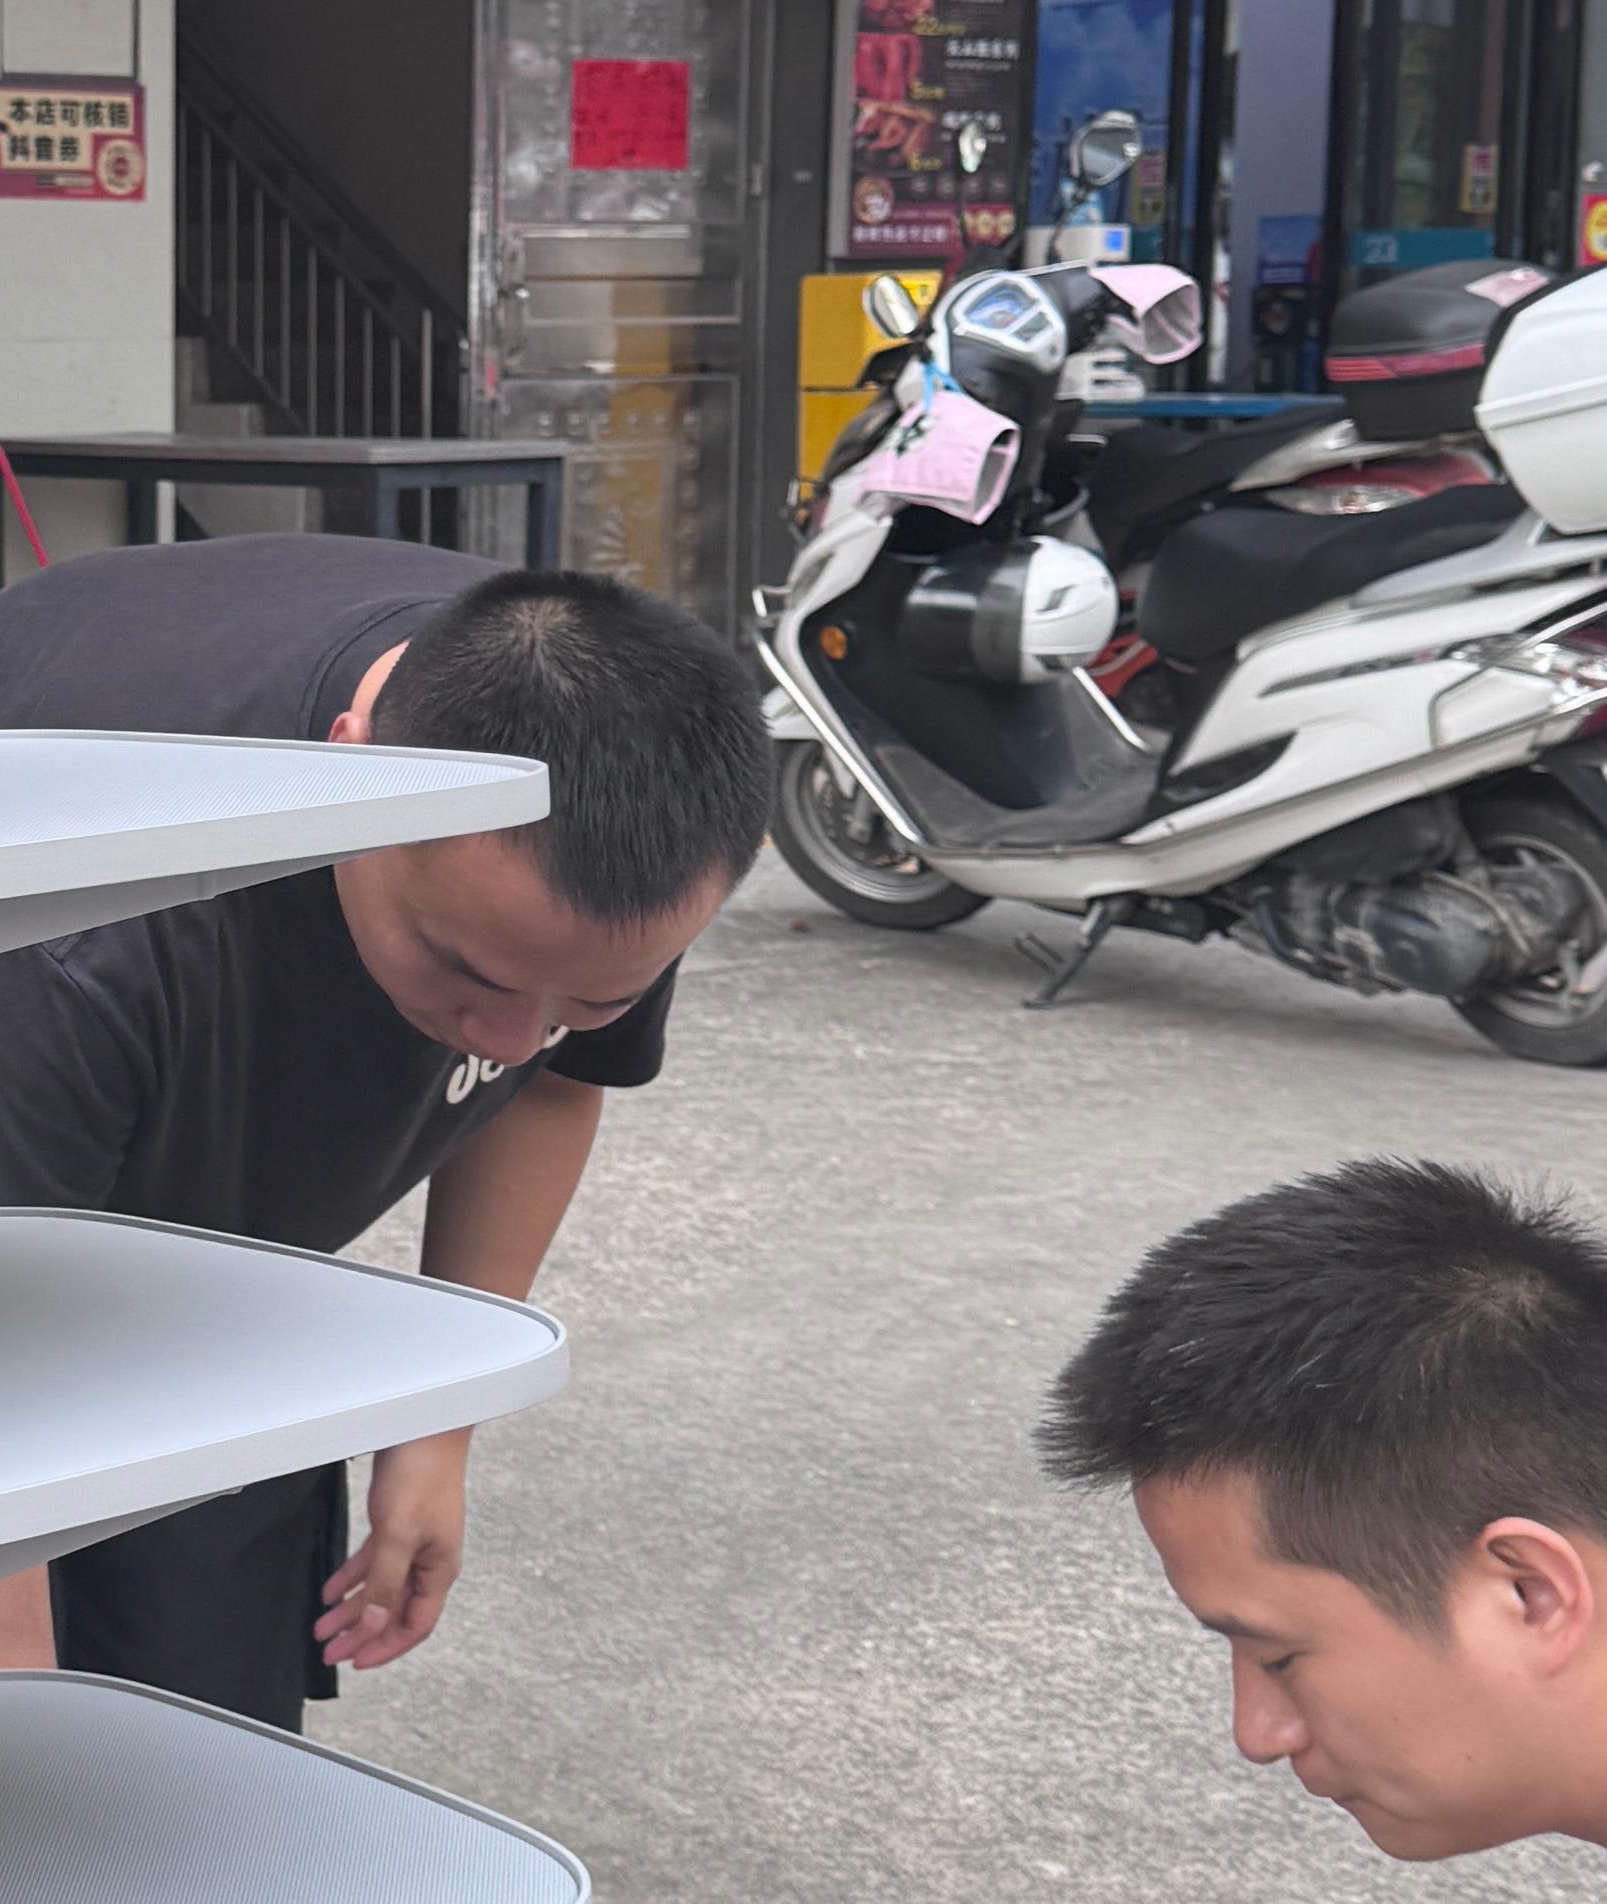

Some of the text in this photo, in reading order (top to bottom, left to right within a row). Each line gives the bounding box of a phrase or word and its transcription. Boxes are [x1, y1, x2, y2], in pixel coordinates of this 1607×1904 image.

[9, 97, 129, 129] 本店可核销
